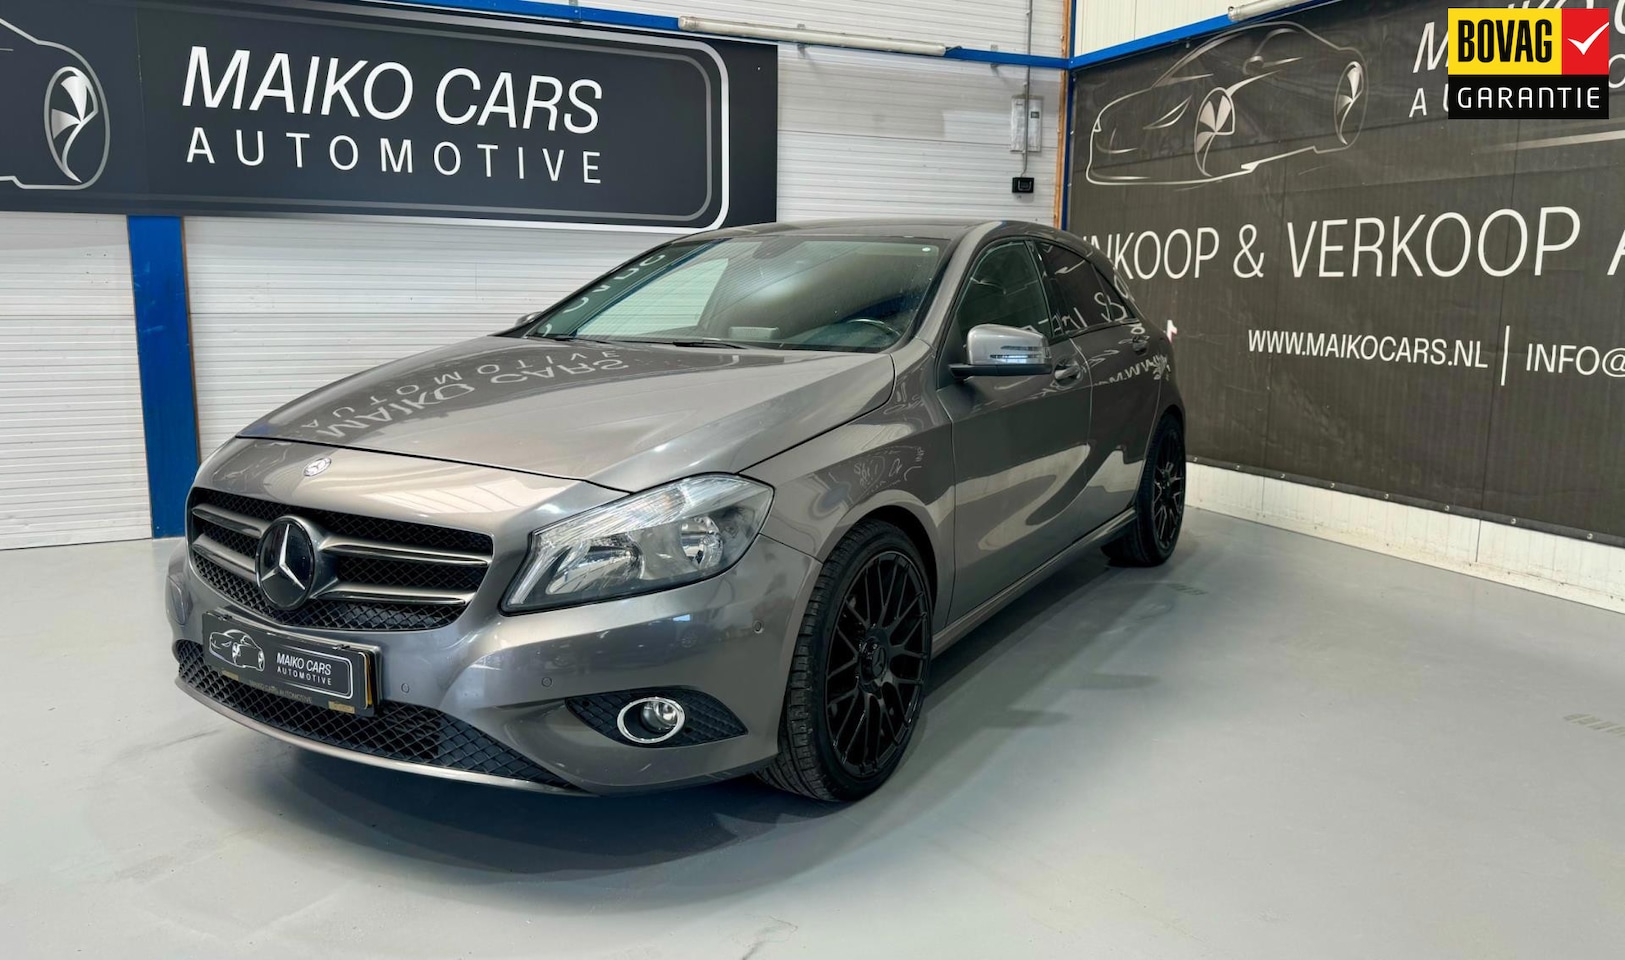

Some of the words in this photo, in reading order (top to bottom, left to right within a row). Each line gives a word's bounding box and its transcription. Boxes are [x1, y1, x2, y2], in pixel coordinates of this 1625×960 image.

[182, 46, 413, 120] MAIKO
[436, 68, 602, 134] CARS
[187, 127, 601, 184] AUTOMOTIVE
[1233, 224, 1265, 279] &
[1287, 206, 1581, 278] VERKOOP
[1249, 329, 1489, 368] WWW.MAIKOCARS.NL
[276, 652, 305, 670] MAIKO
[306, 659, 332, 676] CARS
[276, 666, 332, 686] AUTOMOTIVE
